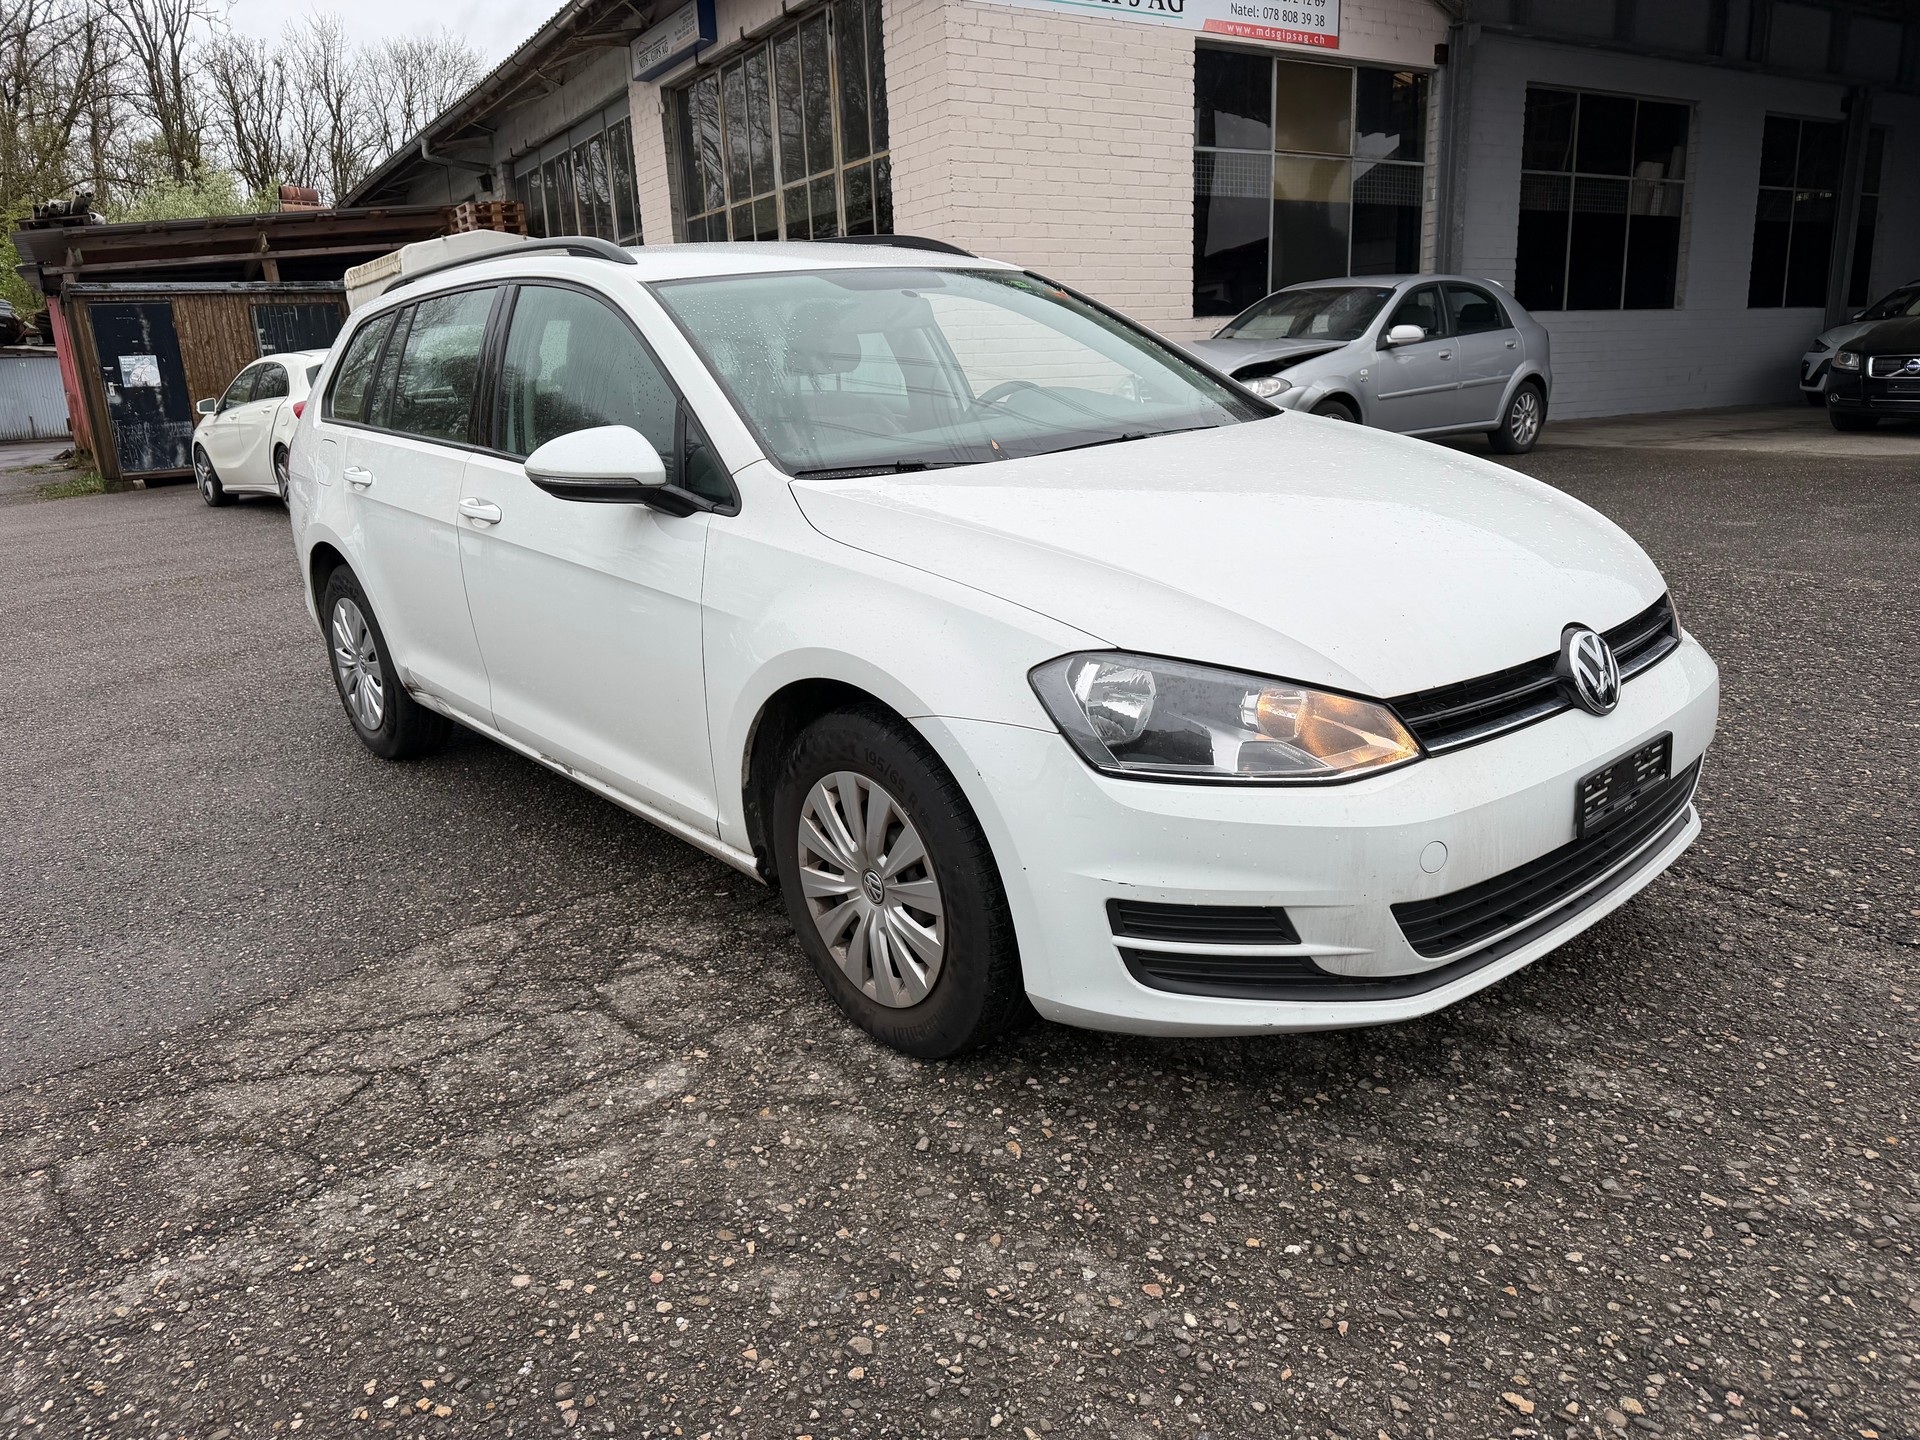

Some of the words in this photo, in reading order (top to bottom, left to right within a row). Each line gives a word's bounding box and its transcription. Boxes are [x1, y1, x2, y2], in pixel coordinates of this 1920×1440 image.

[1230, 2, 1259, 18] Natel:
[1263, 6, 1279, 21] 078
[1282, 9, 1299, 24] 808
[1301, 12, 1312, 25] 39
[1314, 14, 1325, 27] 38
[1227, 24, 1325, 45] www.mdsgipsag.ch
[864, 748, 907, 793] 195/65
